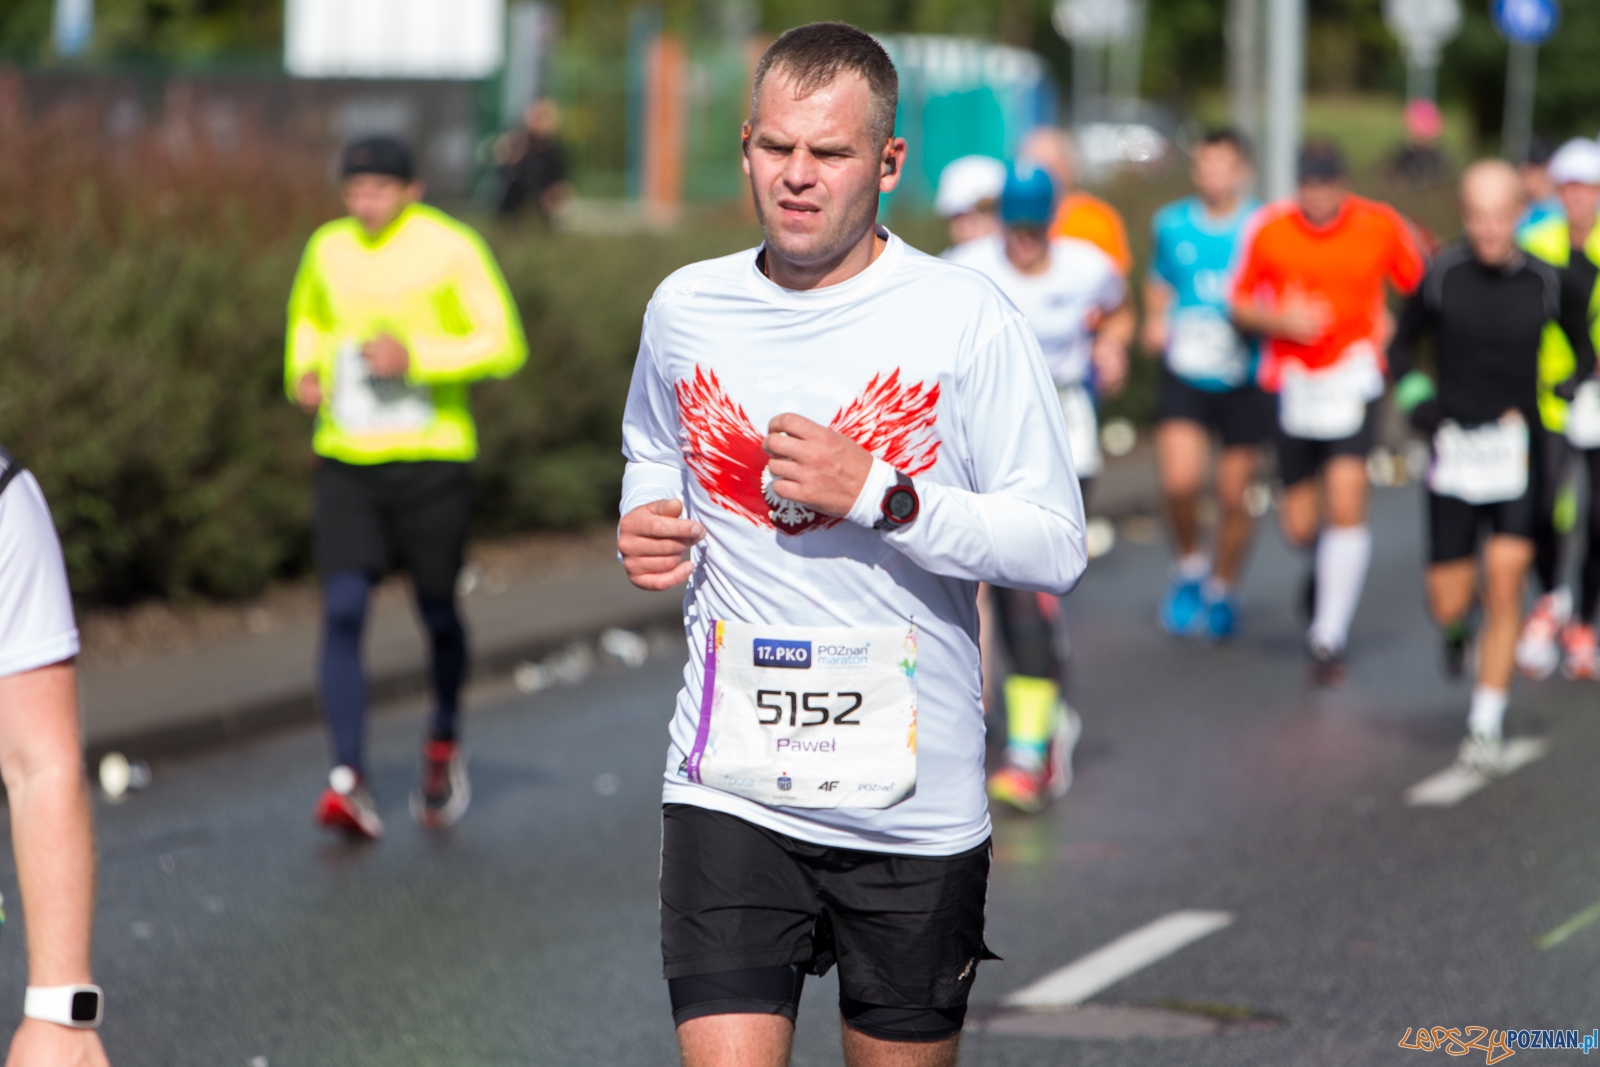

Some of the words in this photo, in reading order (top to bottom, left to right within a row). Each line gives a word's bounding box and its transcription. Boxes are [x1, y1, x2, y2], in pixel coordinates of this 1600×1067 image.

[818, 655, 868, 665] maraton
[756, 689, 863, 727] 5152
[776, 738, 836, 753] Paweł
[818, 780, 840, 792] 4F
